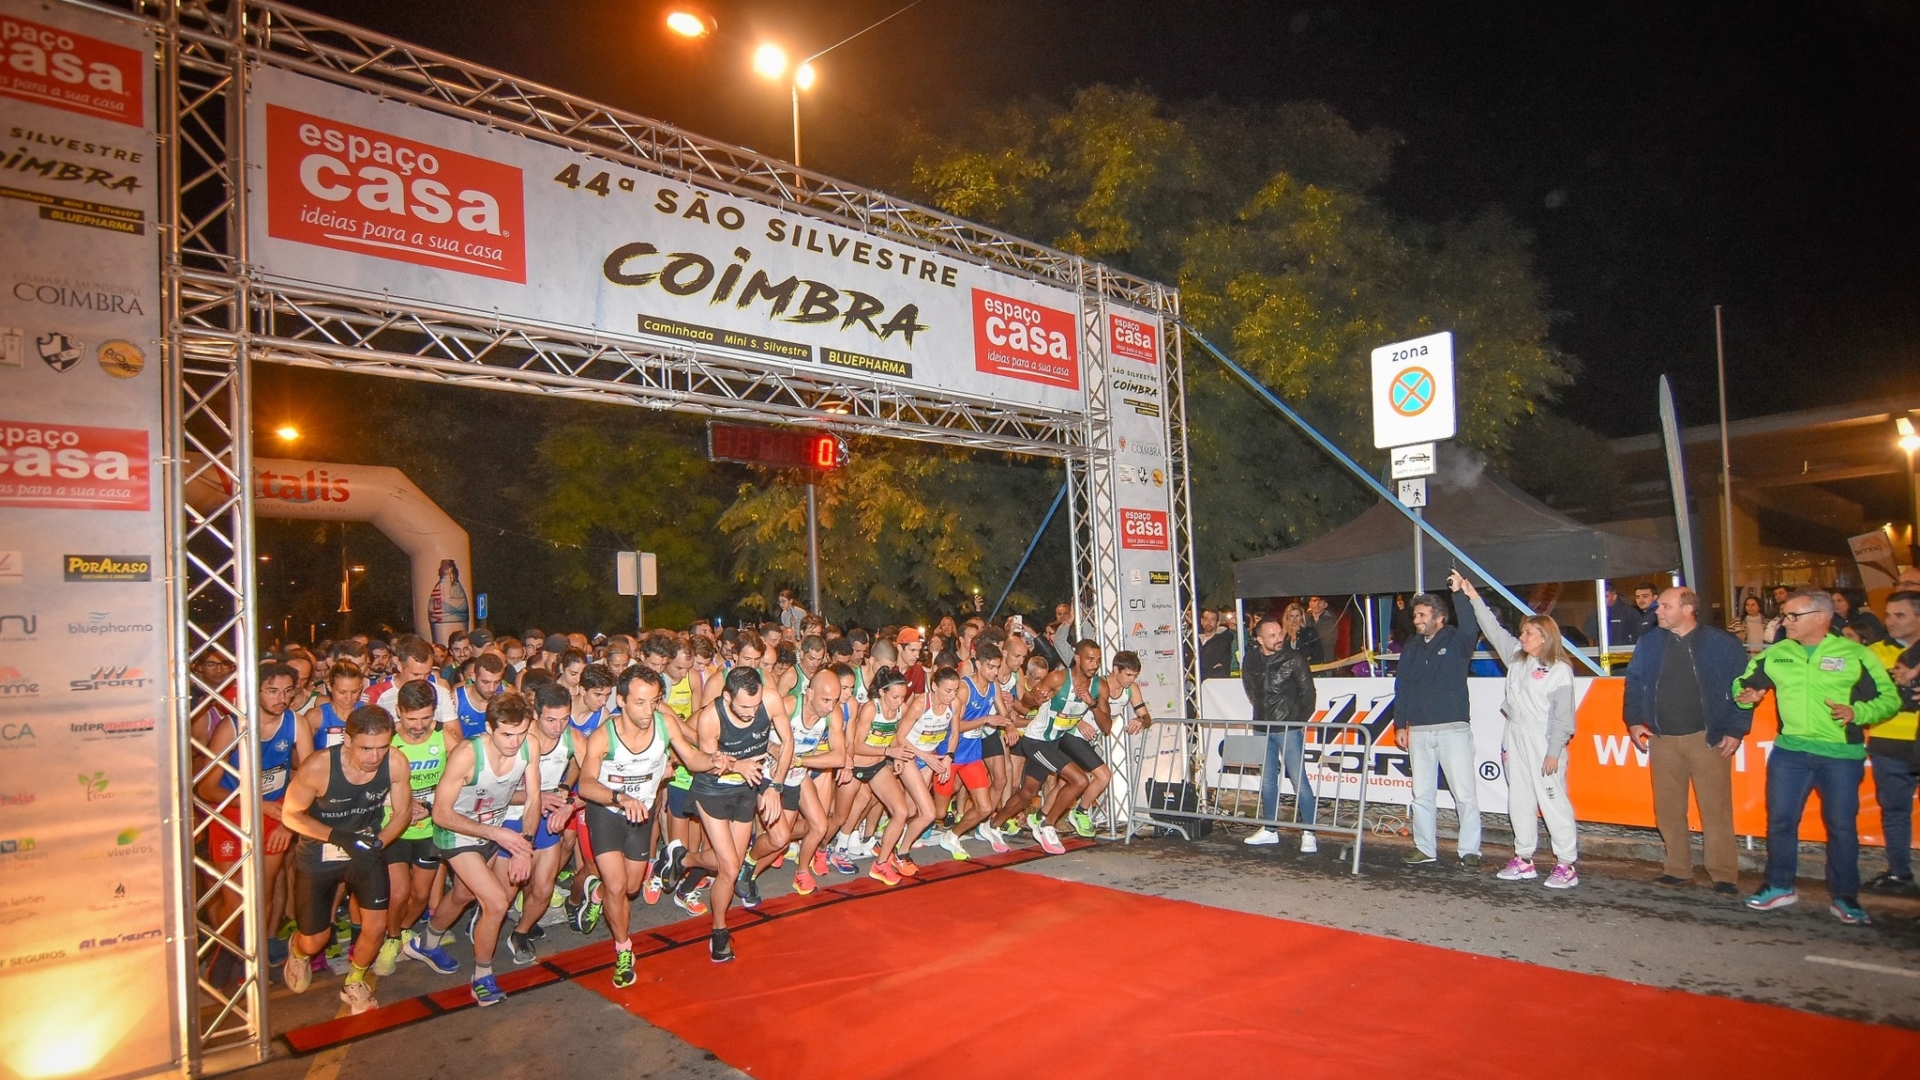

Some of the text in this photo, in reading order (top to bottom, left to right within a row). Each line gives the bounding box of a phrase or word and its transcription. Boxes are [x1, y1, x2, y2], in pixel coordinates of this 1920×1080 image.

[2, 21, 74, 52] paço
[0, 42, 123, 95] asa
[51, 88, 61, 97] a
[65, 90, 90, 104] sua
[93, 97, 125, 112] casa
[9, 127, 143, 164] SILVESTRE
[299, 123, 439, 175] espaço
[300, 153, 502, 237] casa
[51, 210, 135, 232] BLUEPHARMA
[301, 204, 503, 261] ideias para a sua casa
[553, 162, 959, 287] 44ª SÃO SILVESTRE
[13, 283, 145, 316] COIMBRA
[984, 297, 1041, 326] espaço
[1114, 318, 1140, 333] espaço
[644, 320, 808, 357] Caminhada Mini S. Silvestre
[985, 316, 1068, 360] casa
[1115, 327, 1153, 350] casa
[828, 351, 906, 375] BLUEPHARMA
[987, 349, 1010, 365] ideias
[1012, 357, 1030, 368] para
[1038, 362, 1051, 373] sua
[1052, 366, 1069, 377] casa
[1392, 345, 1429, 363] zona
[1127, 371, 1158, 382] SILVESTRE
[1131, 443, 1162, 457] COIMBRA
[18, 484, 52, 496] para
[56, 486, 66, 495] a
[70, 486, 96, 497] sua
[99, 488, 131, 498] casa
[213, 461, 350, 503] Vtalis
[1125, 511, 1151, 522] espaço
[1126, 520, 1164, 537] casa
[68, 623, 154, 637] bluepharma
[70, 679, 147, 692] SPORT
[321, 809, 350, 819] PRIME
[10, 950, 67, 967] SEGUROS
